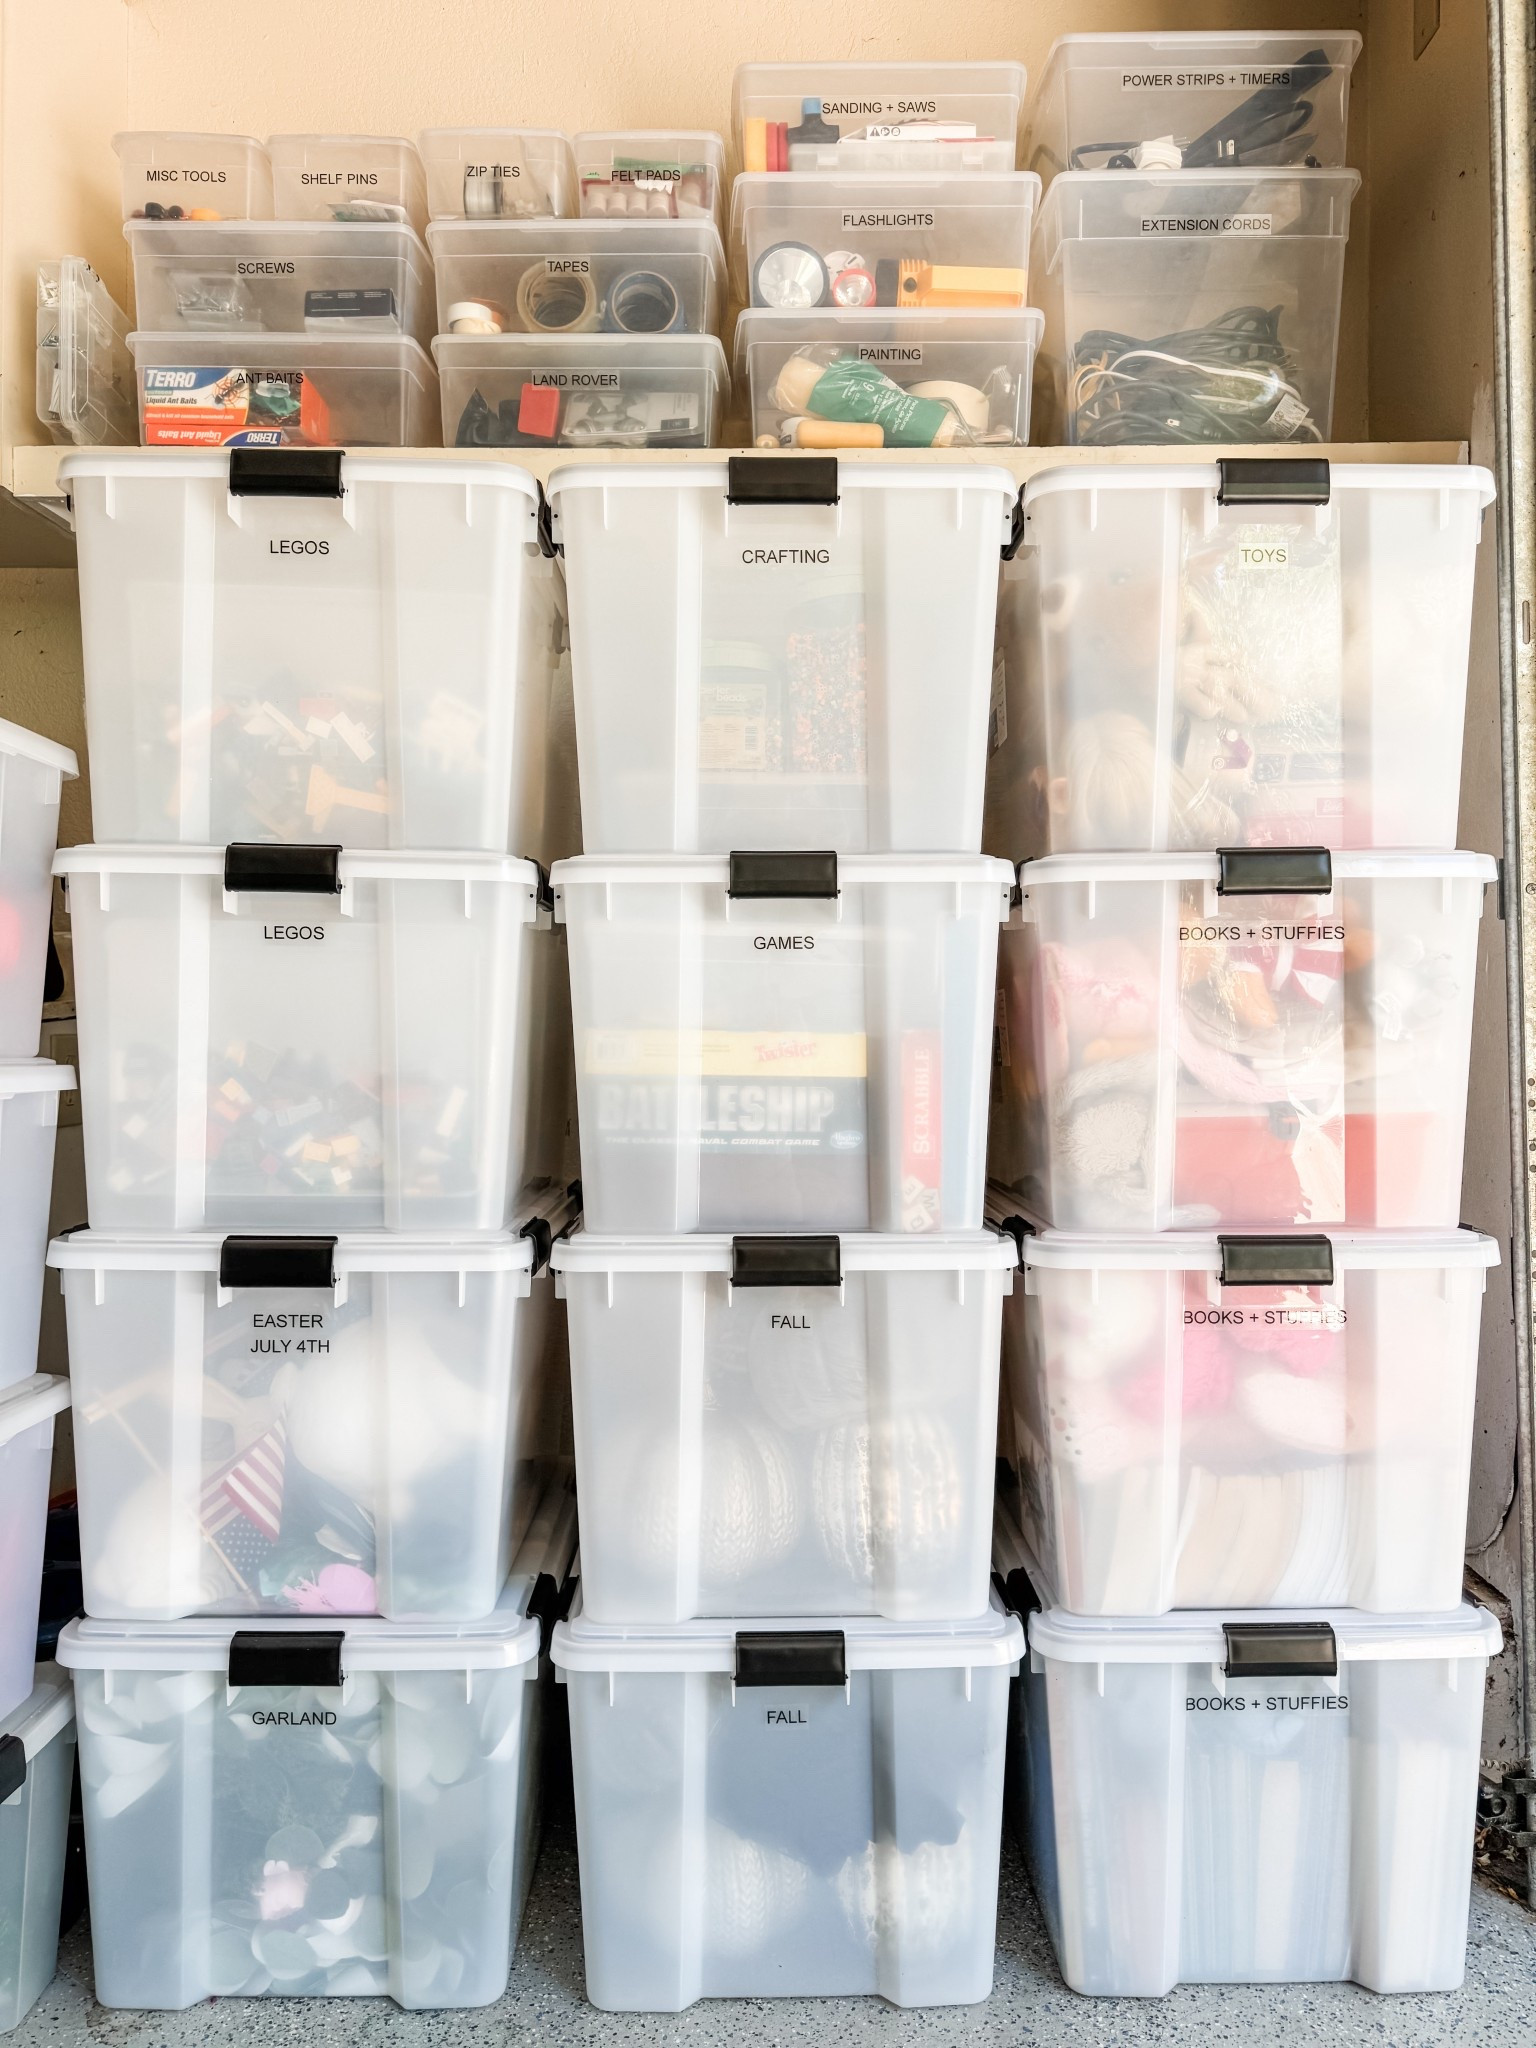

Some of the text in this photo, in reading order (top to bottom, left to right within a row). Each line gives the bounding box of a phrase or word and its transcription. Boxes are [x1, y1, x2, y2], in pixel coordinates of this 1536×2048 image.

[1122, 72, 1290, 87] POWER STRIPS + TIMERS
[822, 101, 937, 115] SANDING + SAWS
[146, 170, 227, 183] MISC TOOLS
[466, 165, 521, 178] ZIP TIES
[610, 169, 681, 182] FELT PADS
[301, 173, 378, 185] SHELF PINS
[843, 213, 934, 227] FLASHLIGHTS
[1141, 218, 1271, 232] EXTENSION CORDS
[237, 262, 295, 275] SCREWS
[547, 260, 590, 273] TAPES
[860, 348, 922, 361] PAINTING
[146, 369, 197, 388] TERRO
[236, 372, 304, 385] ANT BAITS
[532, 374, 618, 387] LAND ROVER
[146, 397, 166, 405] Liquid
[157, 430, 179, 439] Baits
[180, 430, 195, 439] Ant
[196, 430, 222, 441] Liquid
[245, 432, 278, 445] TERRO
[269, 540, 330, 555] LEGOS
[741, 549, 830, 564] CRAFTING
[1240, 548, 1287, 563] TOYS
[263, 925, 325, 941] LEGOS
[1178, 925, 1345, 941] BOOKS + STUFFIES
[753, 935, 815, 950] GAMES
[754, 1040, 818, 1063] Twister
[912, 1048, 930, 1155] SCRABBLE
[631, 1136, 687, 1145] CLASS
[730, 1137, 783, 1146] COMBAT
[784, 1137, 821, 1147] GAME
[252, 1313, 324, 1329] EASTER
[770, 1315, 812, 1329] FALL
[1183, 1310, 1244, 1325] BOOKS
[1249, 1312, 1260, 1323] +
[250, 1338, 331, 1354] JULY 4TH
[1185, 1695, 1349, 1711] BOOKS + STUFFIES
[251, 1710, 338, 1726] GARLAND
[766, 1709, 808, 1725] FALL
